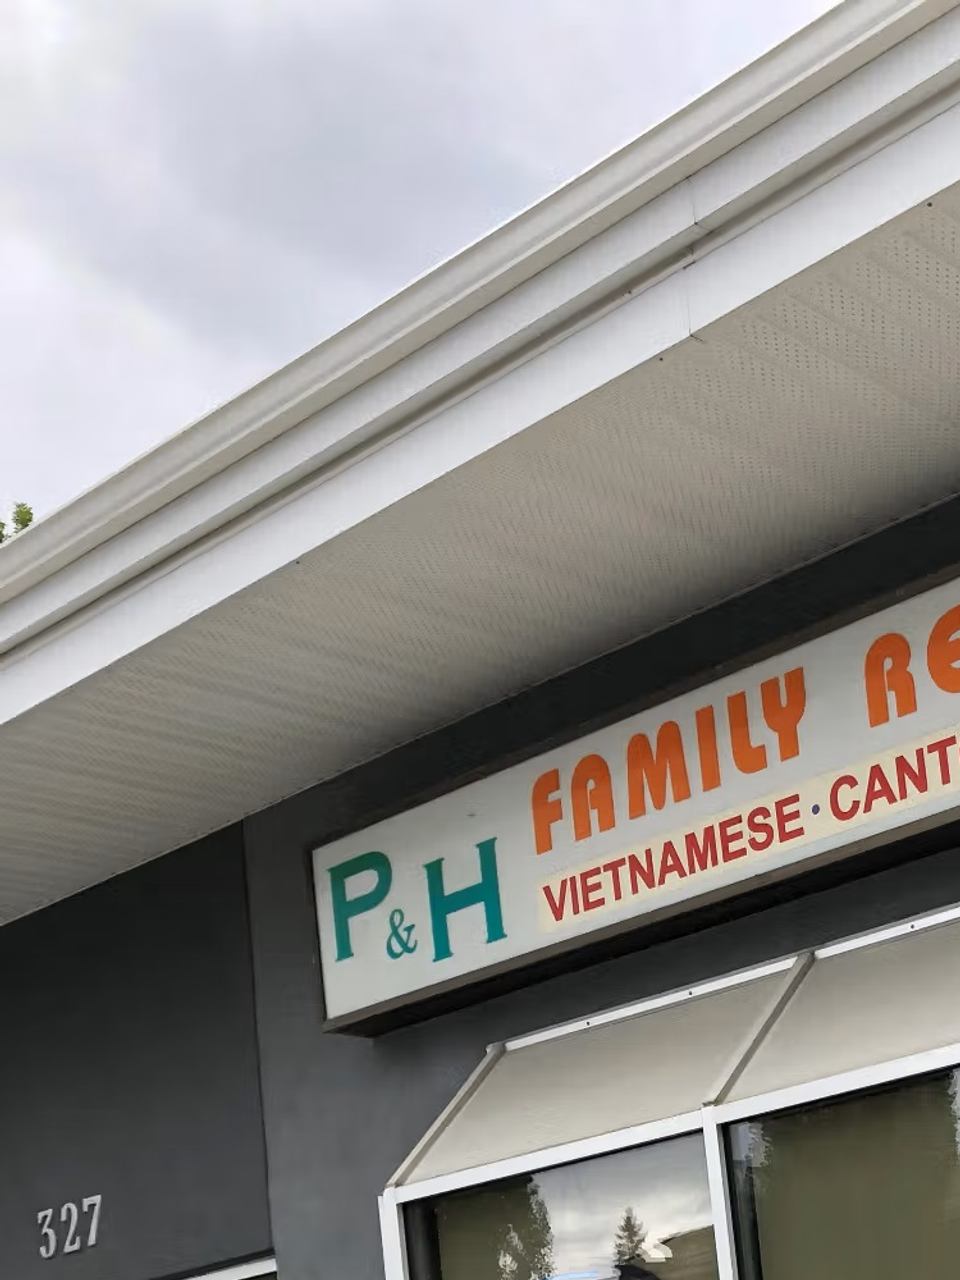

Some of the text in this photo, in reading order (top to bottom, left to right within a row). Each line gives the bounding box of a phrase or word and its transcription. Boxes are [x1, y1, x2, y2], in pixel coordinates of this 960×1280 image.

[531, 666, 807, 855] FAMILY
[542, 794, 805, 923] VIETNAMESE
[37, 1194, 102, 1259] 327
